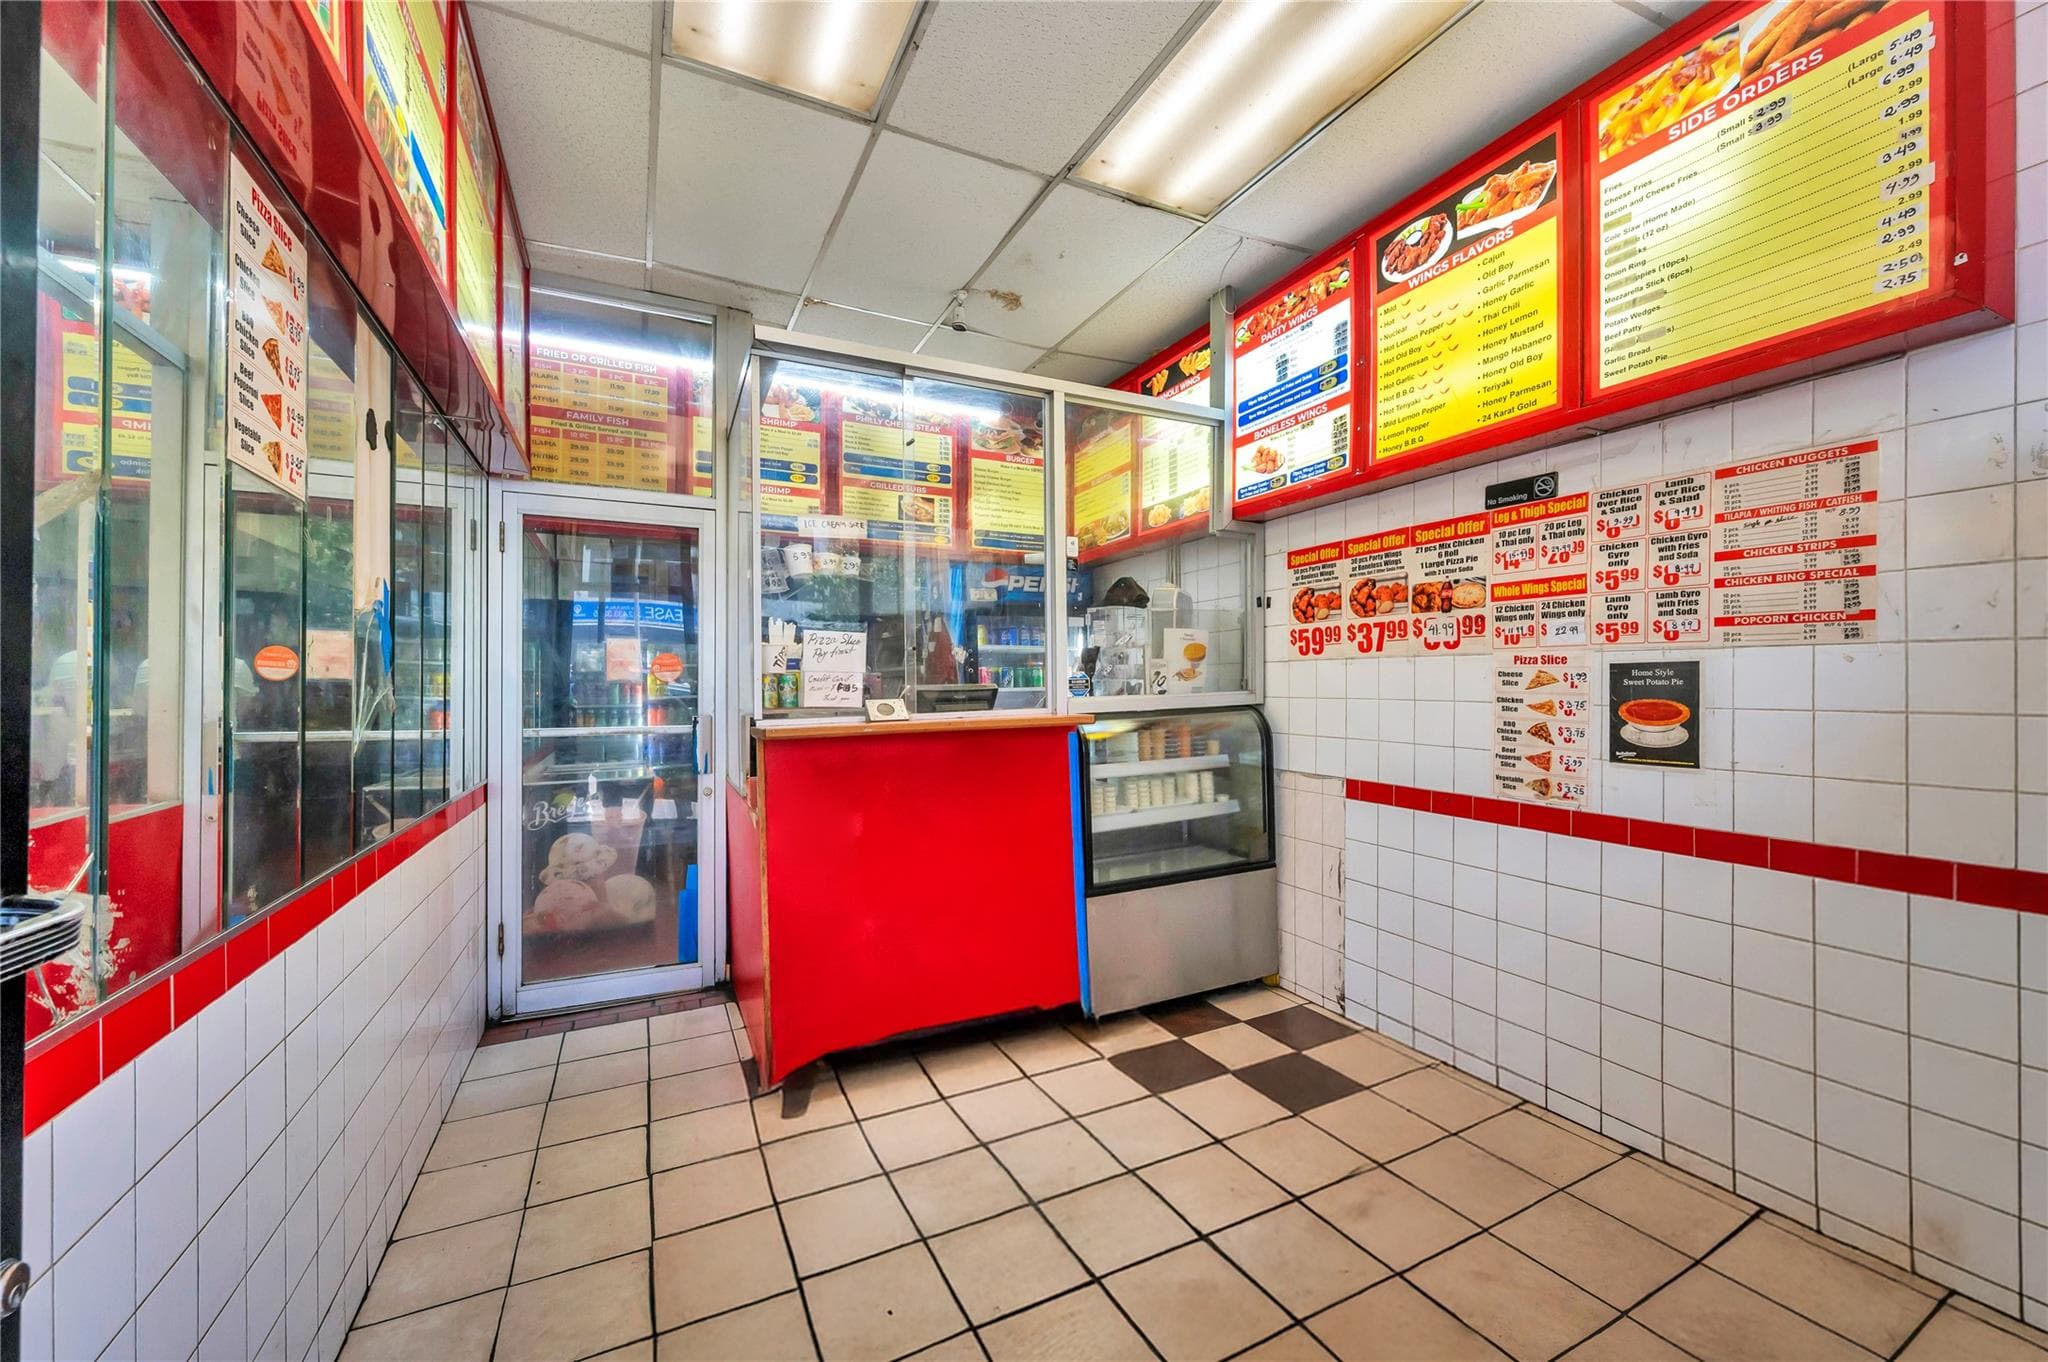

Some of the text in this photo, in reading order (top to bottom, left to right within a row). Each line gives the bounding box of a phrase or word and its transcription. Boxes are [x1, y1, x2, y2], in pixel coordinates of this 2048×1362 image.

[1668, 47, 1825, 141] SIDE ORDERS
[1604, 182, 1623, 195] Fries
[1717, 119, 1747, 138] (Small
[1848, 49, 1884, 73] (Large
[1889, 28, 1922, 52] 5.49
[1604, 43, 1924, 207] Cheese Fries (Small 3.99 (Large 6.49
[1604, 63, 1915, 219] Bacon and Cheese Fries 6.99
[236, 200, 260, 237] Cheese
[251, 186, 293, 253] Pizza Slice
[240, 222, 256, 250] Slice
[1407, 225, 1515, 289] WINGS FLAVORS
[1482, 251, 1505, 267] Cajun
[1604, 206, 1917, 329] Potato Wedges 4.49
[1482, 260, 1515, 281] Old Boy
[1482, 258, 1550, 294] Garlic Parmesan
[1604, 265, 1627, 280] Onion
[1628, 259, 1647, 274] Ring
[1482, 280, 1535, 309] Honey Garlic
[1604, 265, 1695, 306] Mozzarella Stick (6pcs)
[1482, 301, 1521, 322] Thai Chili
[1260, 306, 1319, 345] PARTY WINGS
[1482, 308, 1539, 337] Honey Lemon
[1604, 271, 1918, 379] Sweet Potato Pie 2.75
[1482, 320, 1544, 352] Honey Mustard
[1604, 325, 1643, 344] Beef Patty
[1482, 333, 1552, 366] Mango Habanero
[1604, 346, 1652, 367] Garlic Bread
[536, 347, 657, 374] FRIED OR GRILLED FISH
[1482, 351, 1544, 381] Honey Old Boy
[1482, 378, 1514, 395] Teriyaki
[1482, 379, 1552, 409] Honey Parmesan
[566, 411, 629, 427] FAMILY FISH
[1482, 398, 1538, 423] 24 Karat Gold
[760, 417, 798, 429] SHRIMP
[1254, 402, 1329, 441] BONELESS WINGS
[1005, 454, 1036, 465] BURGER
[1736, 446, 1849, 475] CHICKEN NUGGETS
[1497, 492, 1528, 505] Smoking
[1596, 494, 1643, 509] Over Rice
[1599, 487, 1640, 500] Chicken
[1494, 495, 1586, 525] Leg & Thigh Special
[1609, 503, 1638, 515] Salad
[1723, 494, 1862, 521] TILAPIA WHITING FISH CATFISH
[1415, 519, 1486, 543] Special Offer
[1545, 518, 1582, 531] 20 pc Leg
[1347, 533, 1406, 555] Special Offer
[1423, 545, 1436, 556] pcs
[1438, 541, 1451, 552] Mix
[1453, 537, 1486, 550] Chicken
[1599, 541, 1639, 552] Chicken
[1650, 531, 1708, 546] Chicken Gyro
[1657, 541, 1700, 553] with Fries
[1743, 540, 1838, 558] CHICKEN STRIPS
[1290, 547, 1339, 567] Special Offer
[1425, 560, 1445, 572] Large
[1446, 557, 1465, 568] Pizza
[1466, 554, 1480, 565] Pie
[1608, 551, 1630, 561] Gyro
[1608, 558, 1629, 568] only
[1658, 549, 1699, 562] and Soda
[1724, 567, 1860, 587] CHICKEN RING SPECIAL
[1493, 577, 1586, 599] Whole Wings Special
[1540, 608, 1586, 621] Wings only
[1541, 598, 1585, 610] 24 Chicken
[1734, 611, 1847, 626] POPCORN CHICKEN
[1513, 653, 1568, 665] Pizza Slice
[1623, 677, 1684, 687] Sweet Potato Pie
[1631, 668, 1675, 678] Home Style
